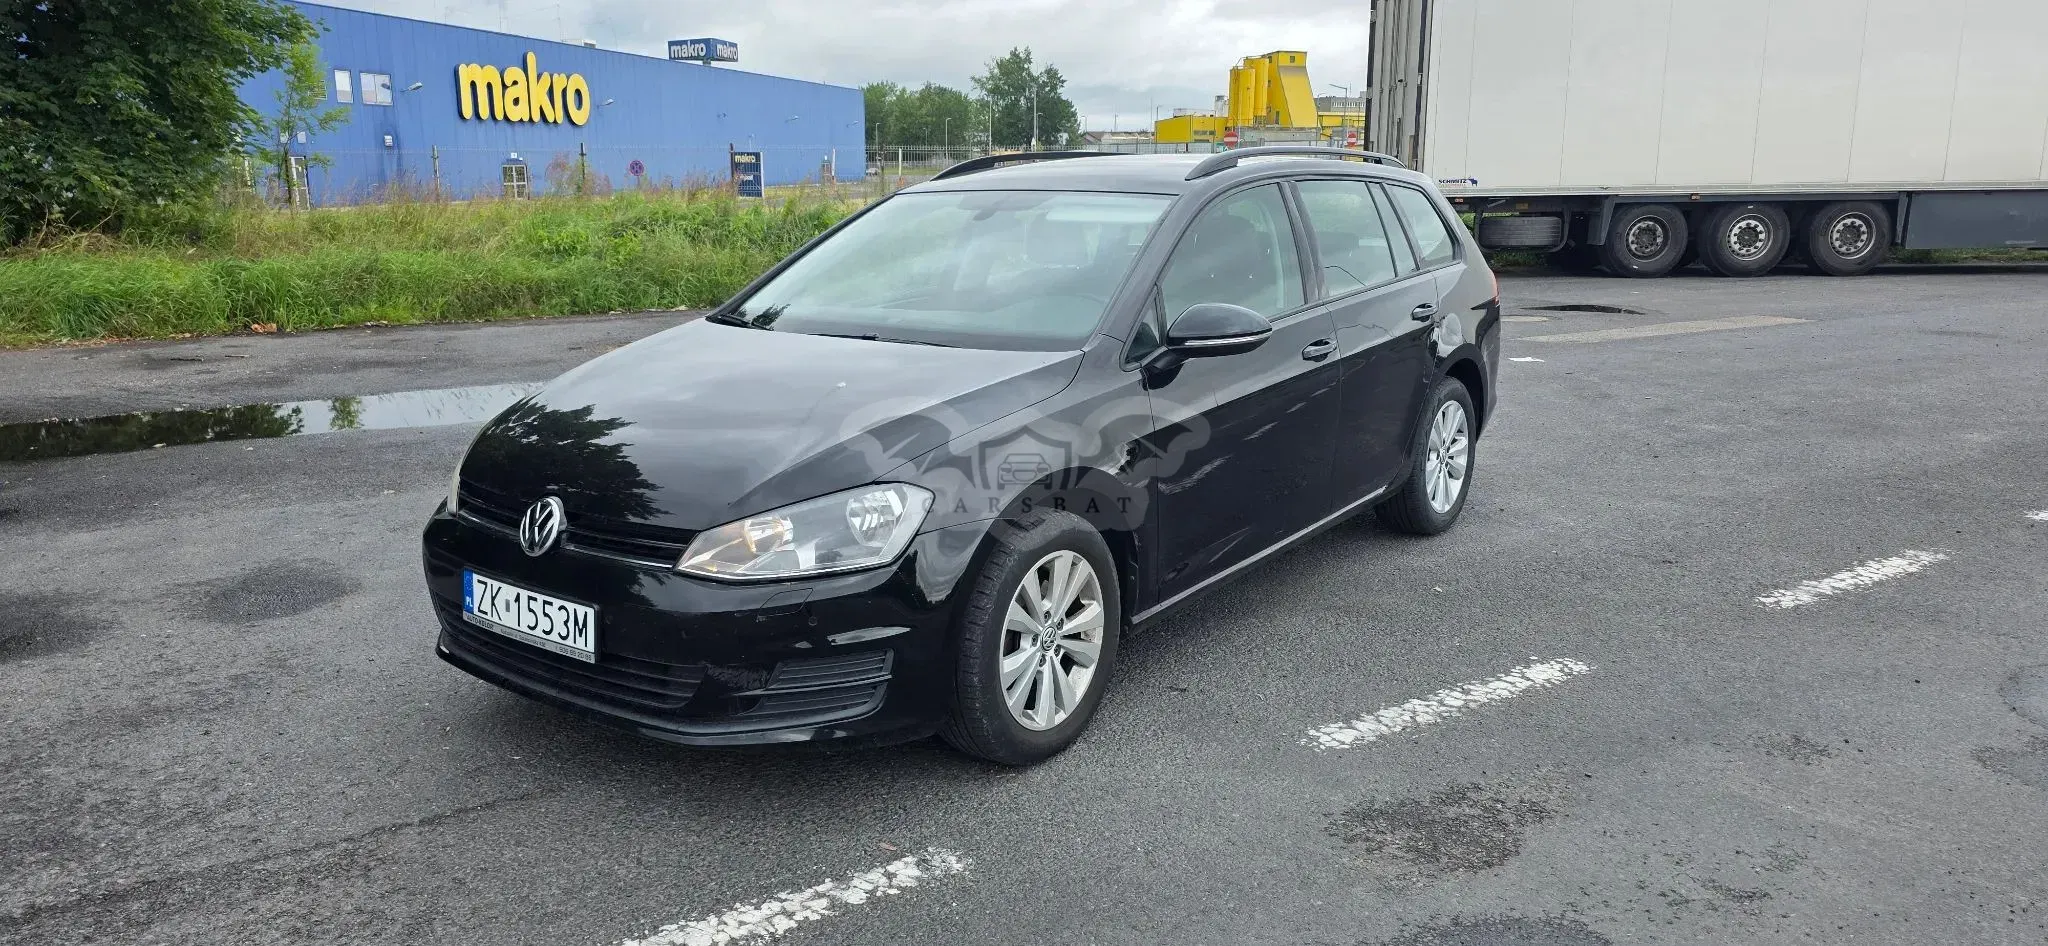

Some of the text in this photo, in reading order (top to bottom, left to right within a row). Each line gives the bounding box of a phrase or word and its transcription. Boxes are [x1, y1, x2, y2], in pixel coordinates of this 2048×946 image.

[671, 41, 706, 58] makro
[717, 42, 738, 60] makro
[457, 51, 591, 126] makro
[735, 153, 756, 163] makro
[477, 579, 502, 621] ZK
[514, 592, 588, 647] 1553M
